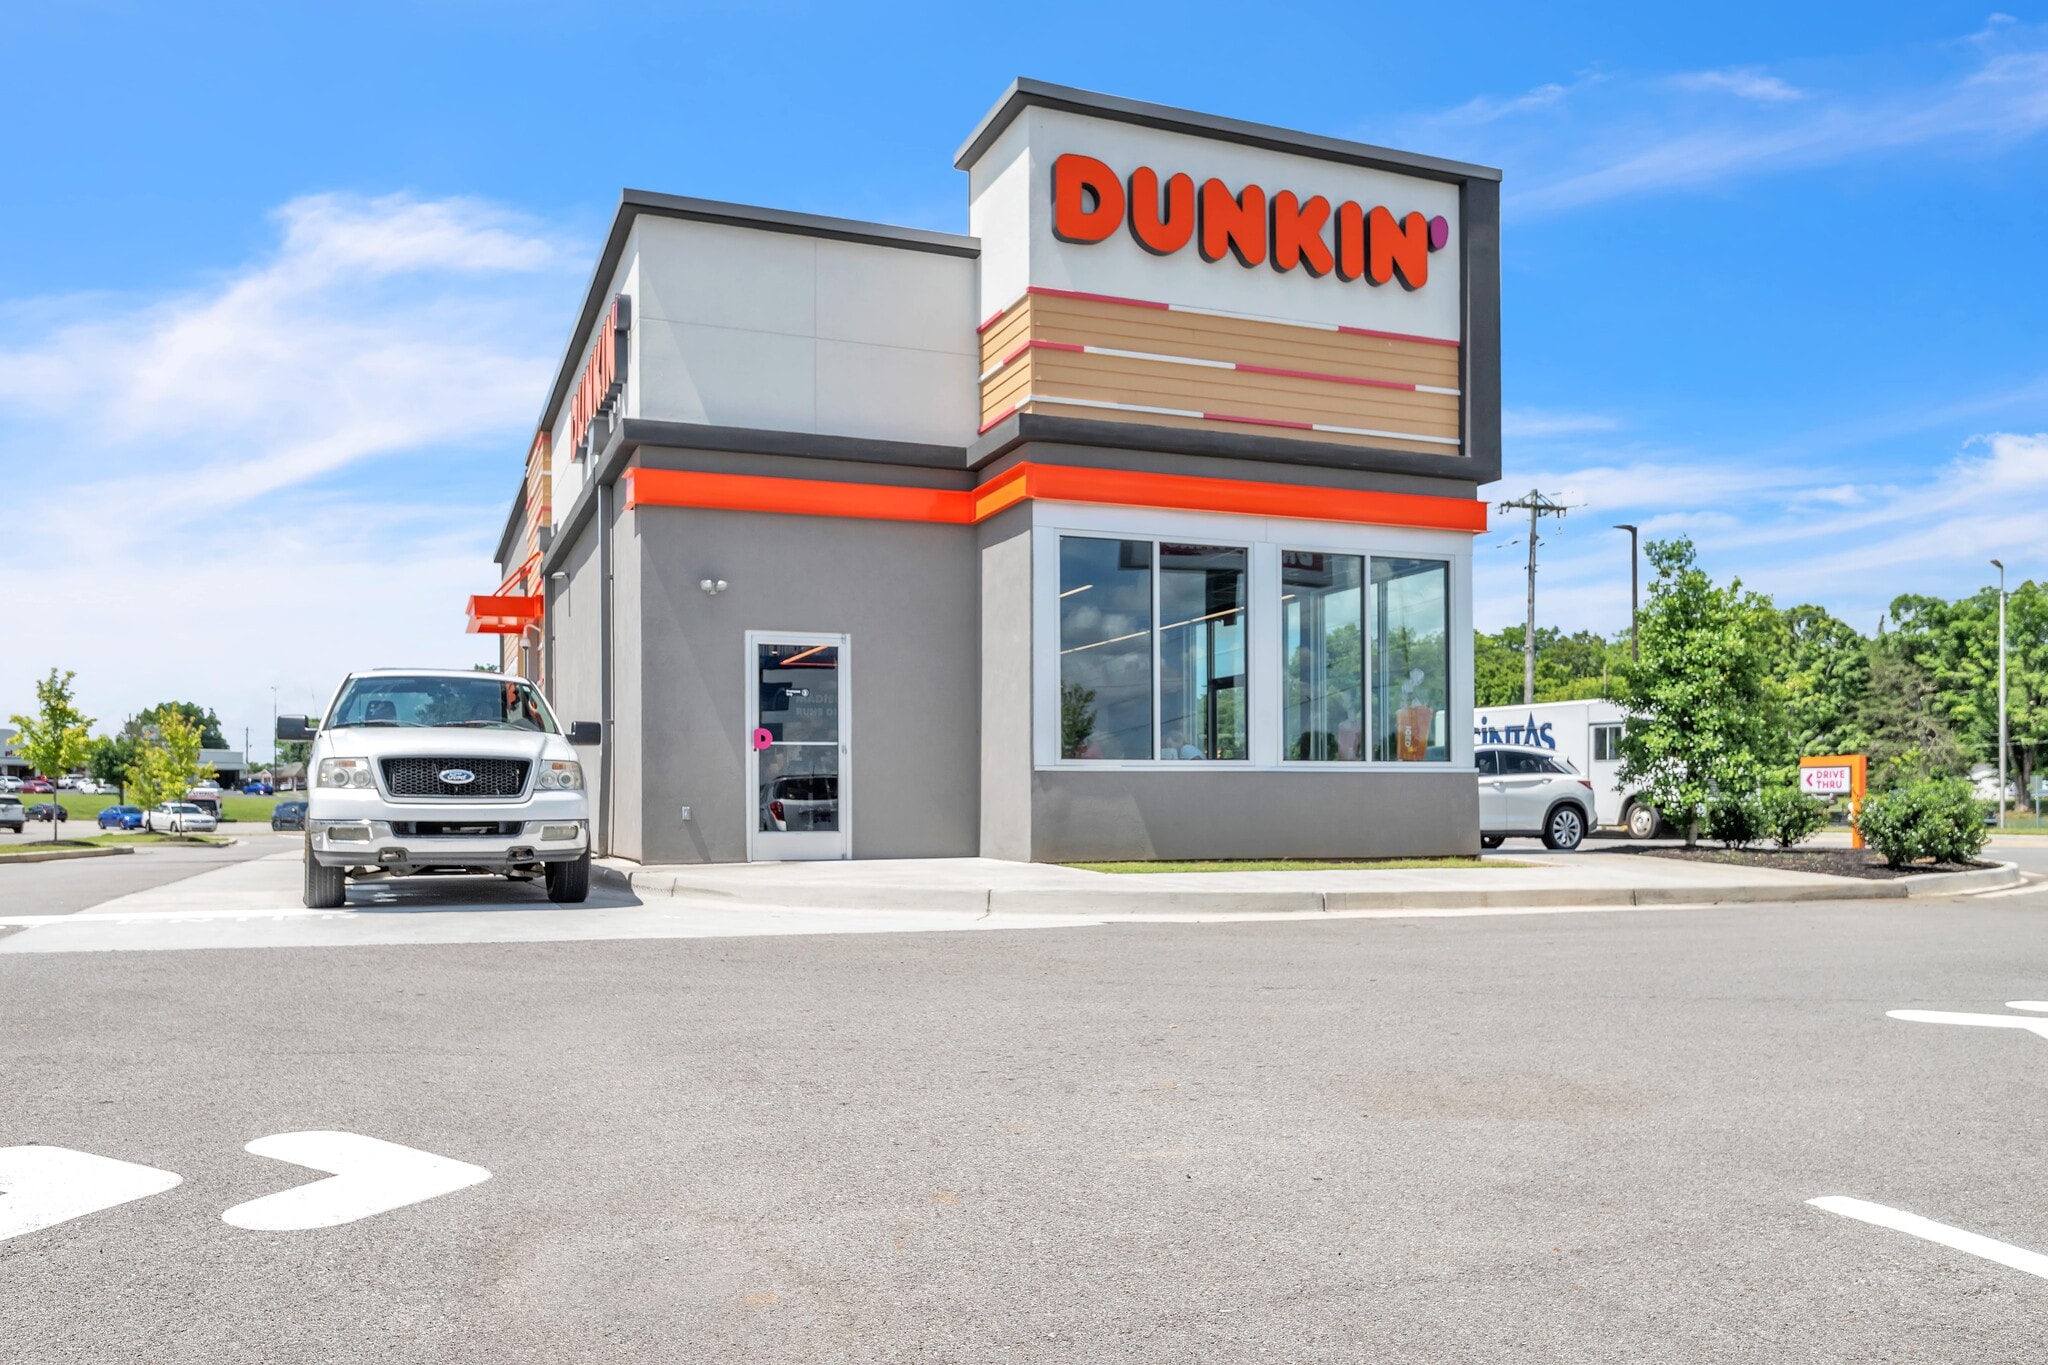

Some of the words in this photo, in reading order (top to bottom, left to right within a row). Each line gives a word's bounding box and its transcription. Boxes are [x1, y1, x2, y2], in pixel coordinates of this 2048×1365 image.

[1051, 153, 1450, 292] DUNKIN'
[1816, 770, 1845, 779] DRIVE
[1816, 781, 1843, 789] THRU
